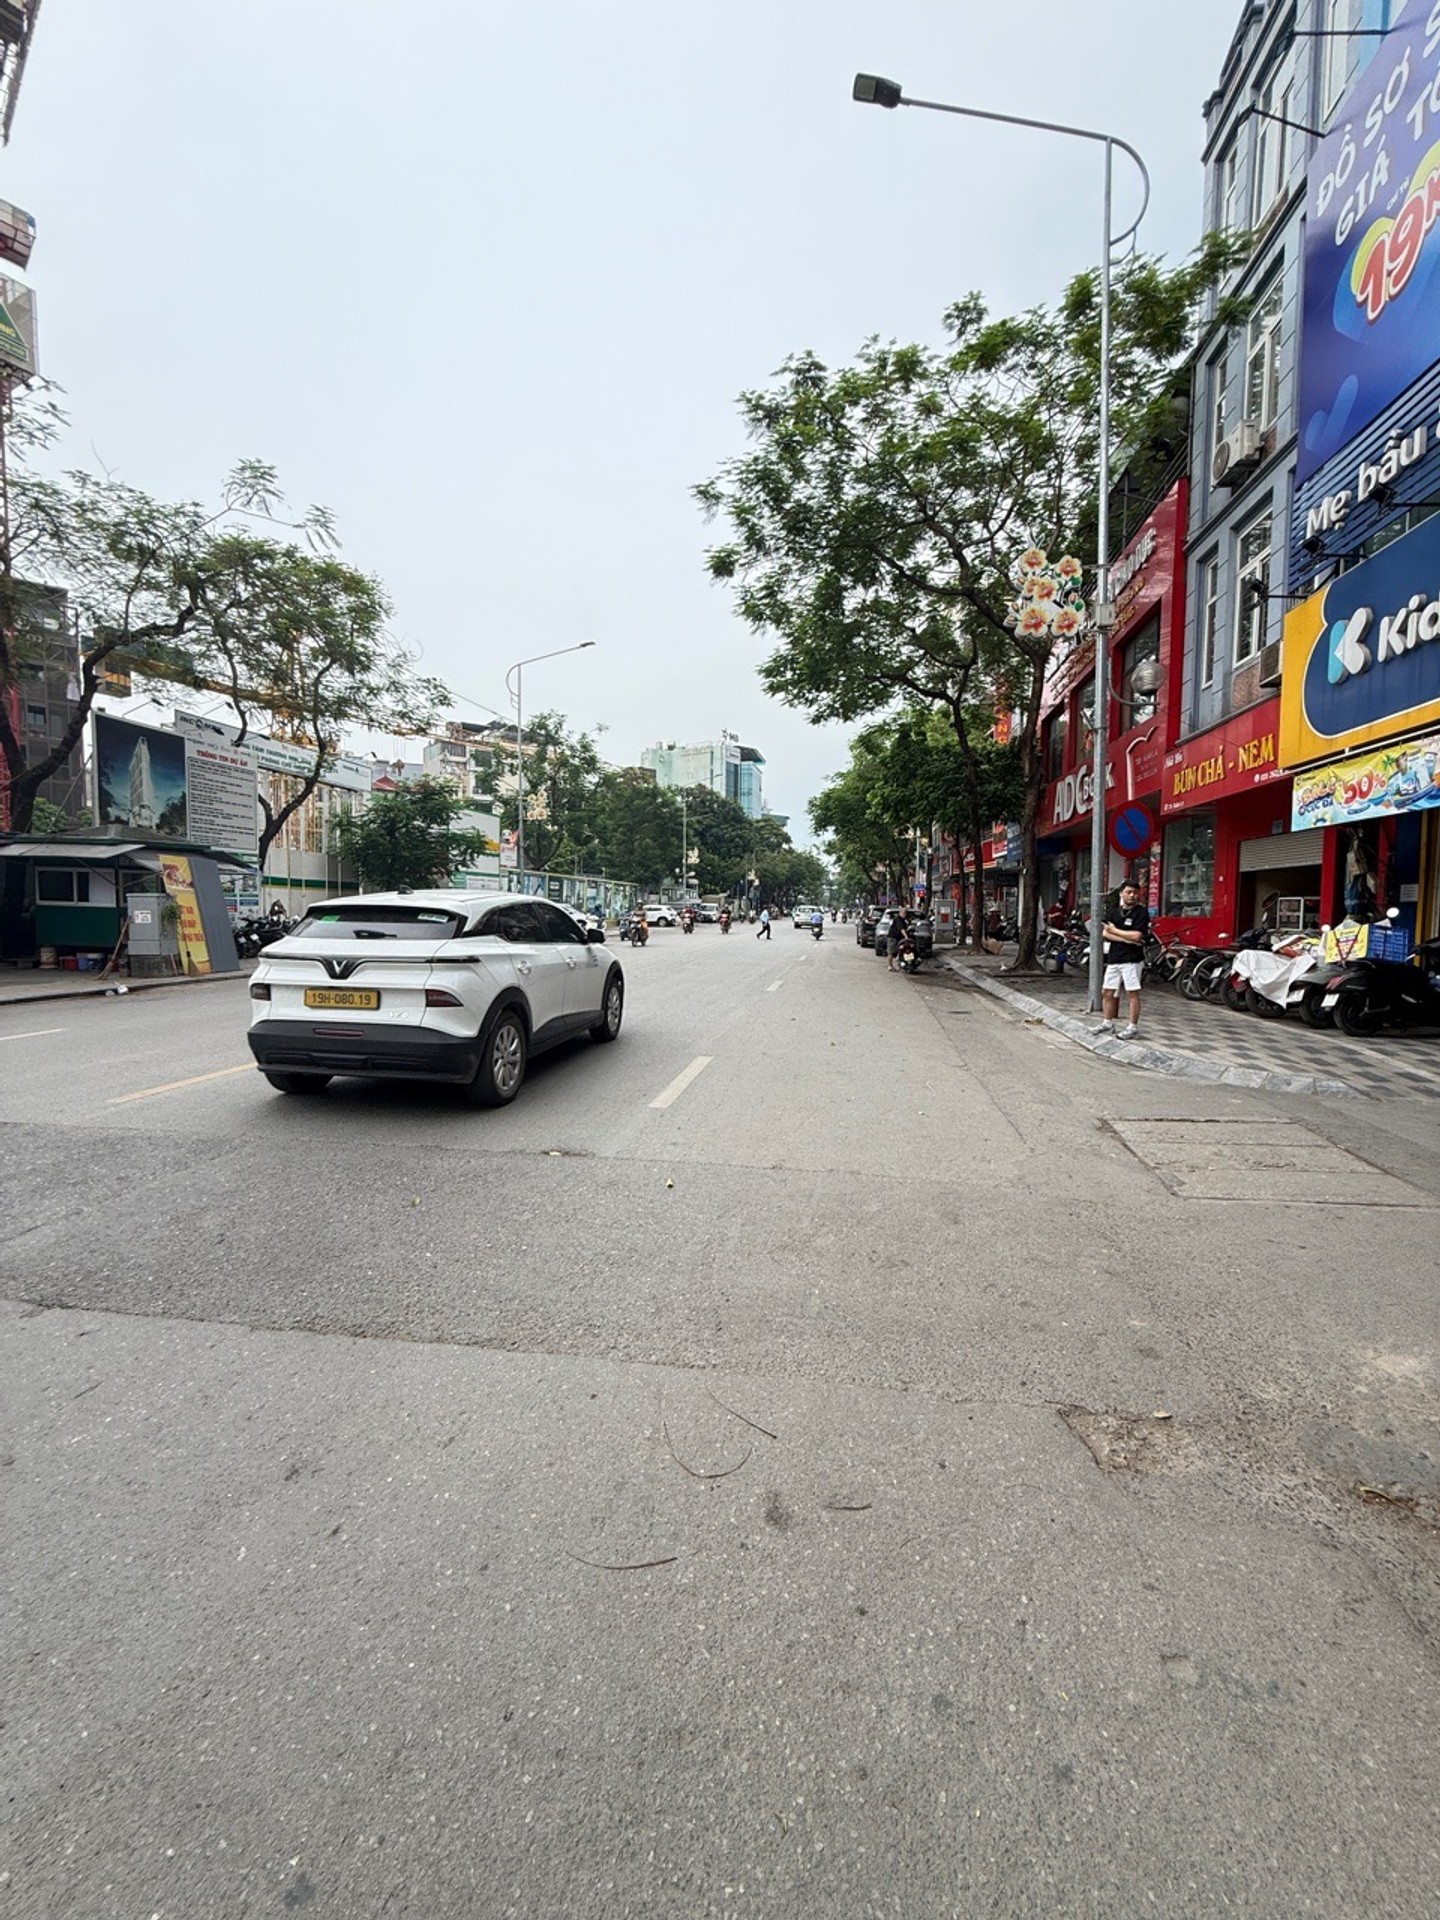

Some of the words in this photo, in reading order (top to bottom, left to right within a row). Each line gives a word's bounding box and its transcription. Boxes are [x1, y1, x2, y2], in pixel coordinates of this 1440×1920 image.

[1335, 134, 1390, 247] GIÁ
[1306, 490, 1353, 540] Mẹ
[1357, 426, 1428, 503] bầu
[1173, 763, 1197, 796] BÚN
[1197, 745, 1226, 786] CHẢ
[312, 992, 372, 1006] 19H-080.19
